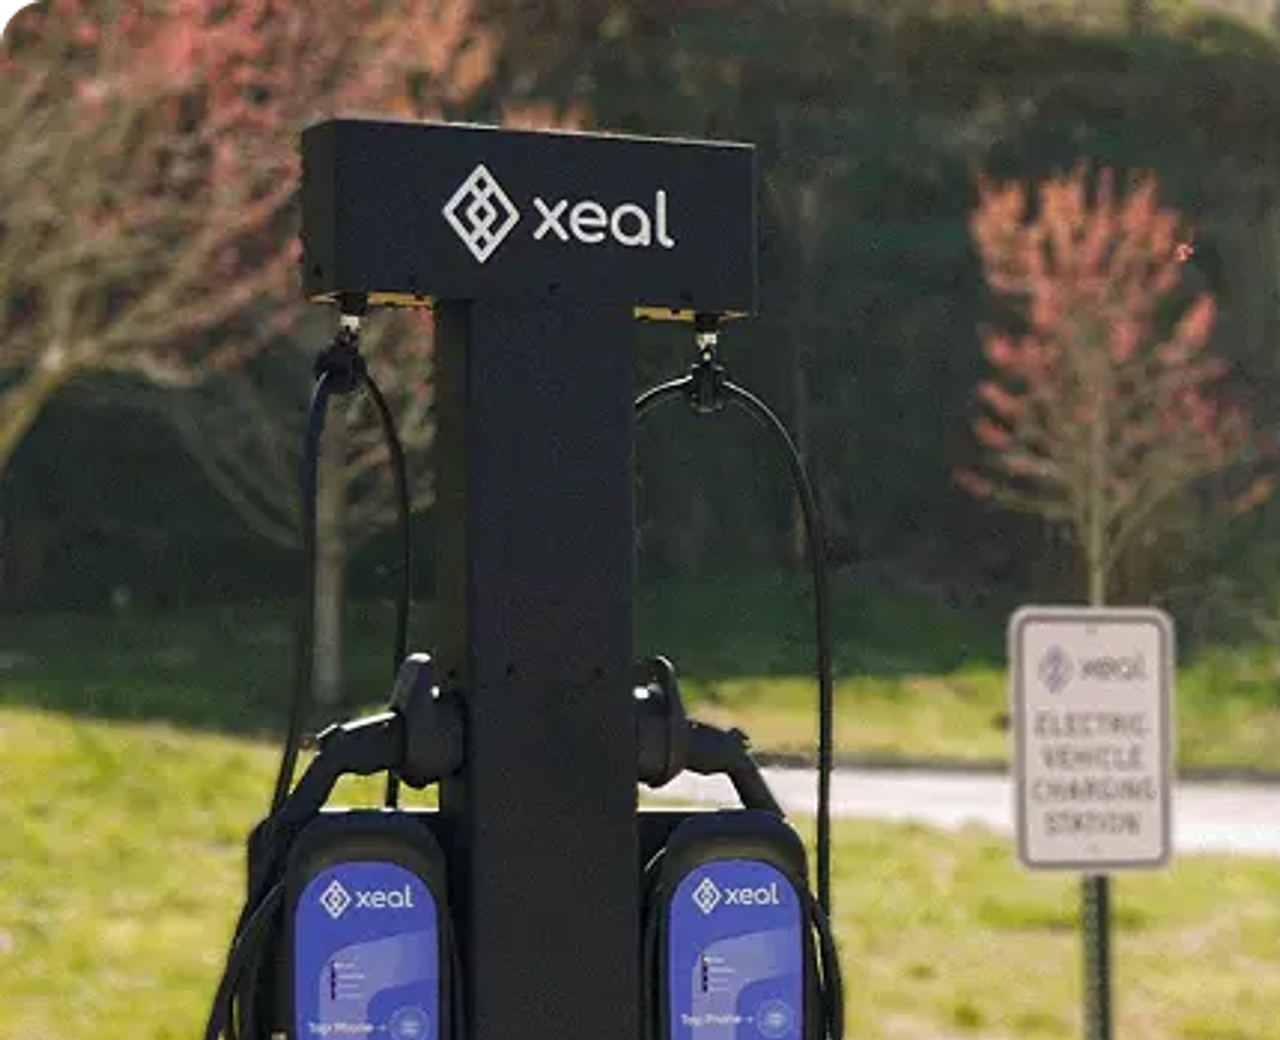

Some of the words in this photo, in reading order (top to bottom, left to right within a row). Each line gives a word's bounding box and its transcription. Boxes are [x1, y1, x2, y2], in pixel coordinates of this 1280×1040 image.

[532, 189, 676, 250] xeal
[1035, 711, 1149, 738] ELECTRIC
[1041, 745, 1143, 770] VEHICLE
[1031, 776, 1158, 802] CHARGING
[1044, 810, 1141, 836] STATION
[356, 885, 414, 908] xeal
[724, 882, 780, 906] xeal
